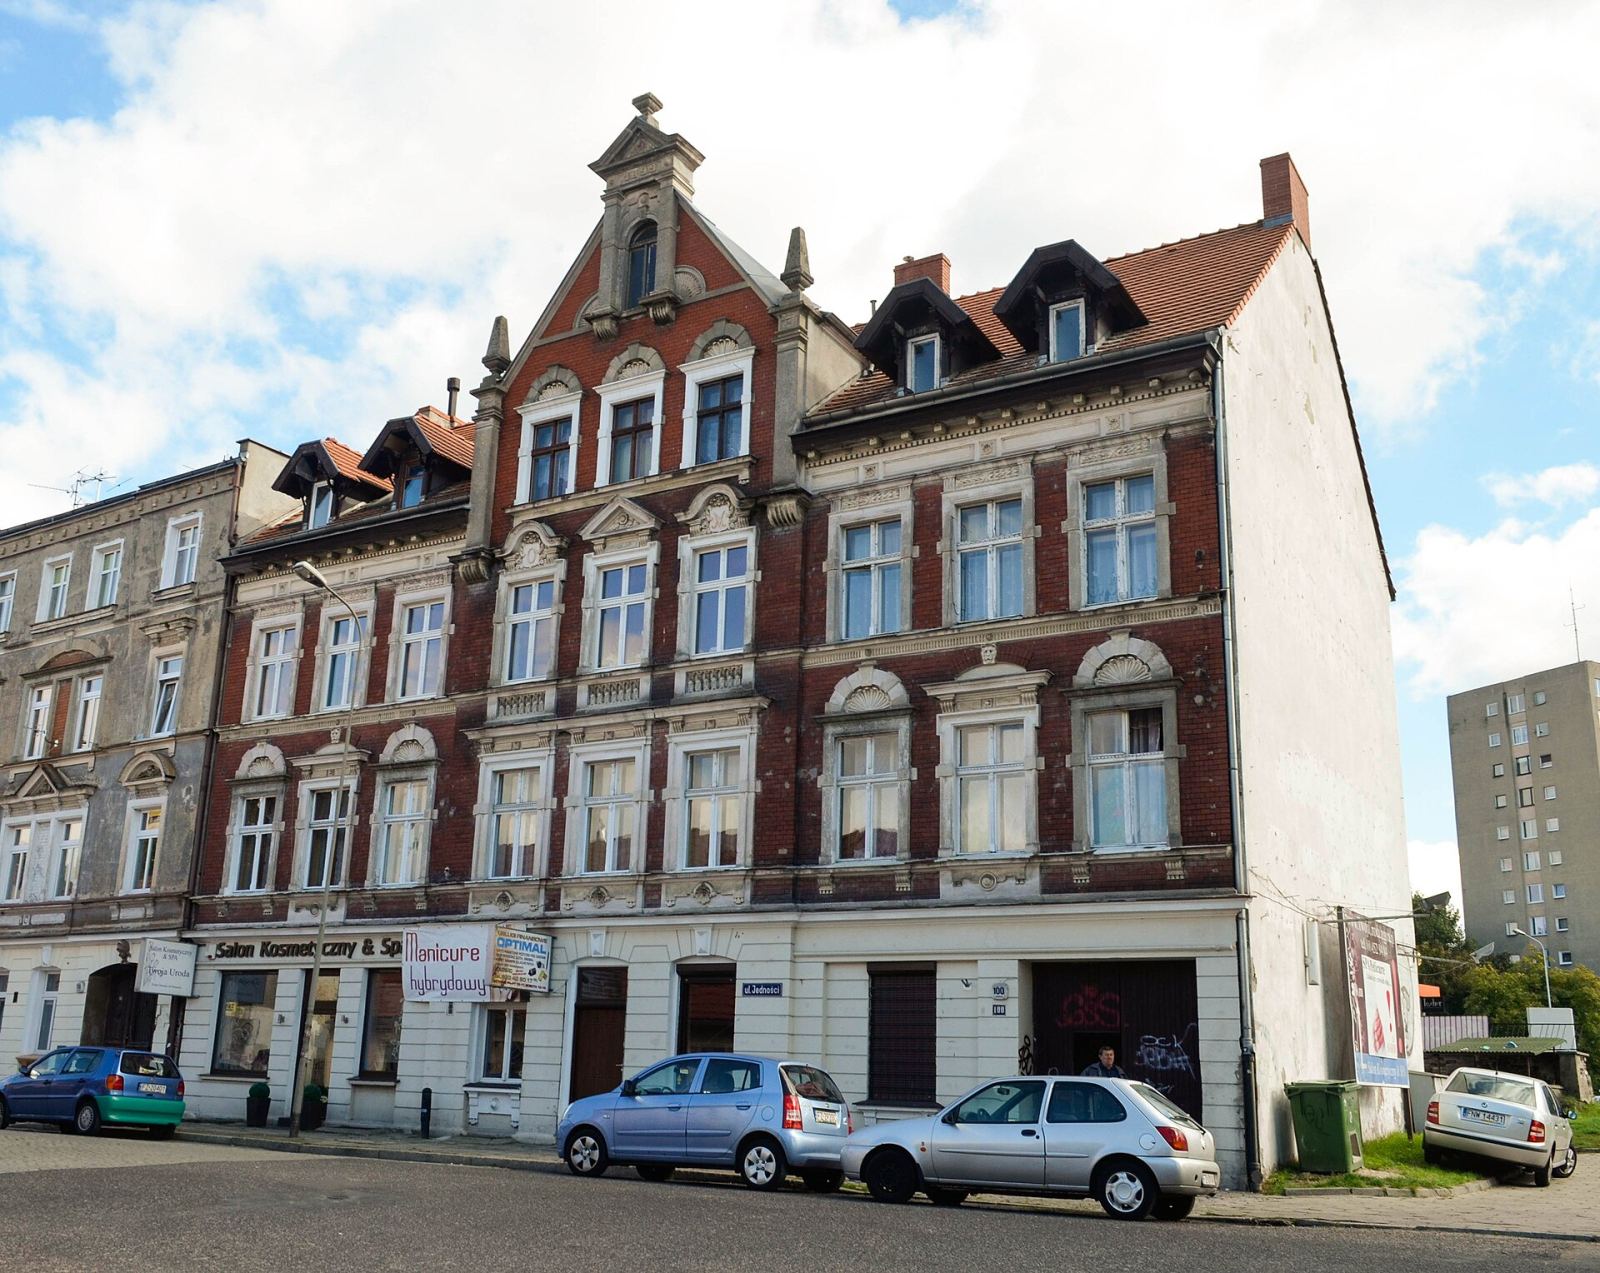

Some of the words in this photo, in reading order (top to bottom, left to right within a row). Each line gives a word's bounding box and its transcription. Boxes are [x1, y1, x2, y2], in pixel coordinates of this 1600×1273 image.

[215, 941, 255, 959] Salon
[362, 938, 375, 956] &
[380, 937, 403, 958] Sp
[405, 932, 480, 962] Manicure
[496, 937, 547, 955] OPTIMAL
[147, 965, 168, 977] Twoja
[169, 968, 190, 978] Uroda
[410, 965, 486, 996] hybrydowy
[993, 986, 1005, 995] 100
[993, 1006, 1005, 1014] 100
